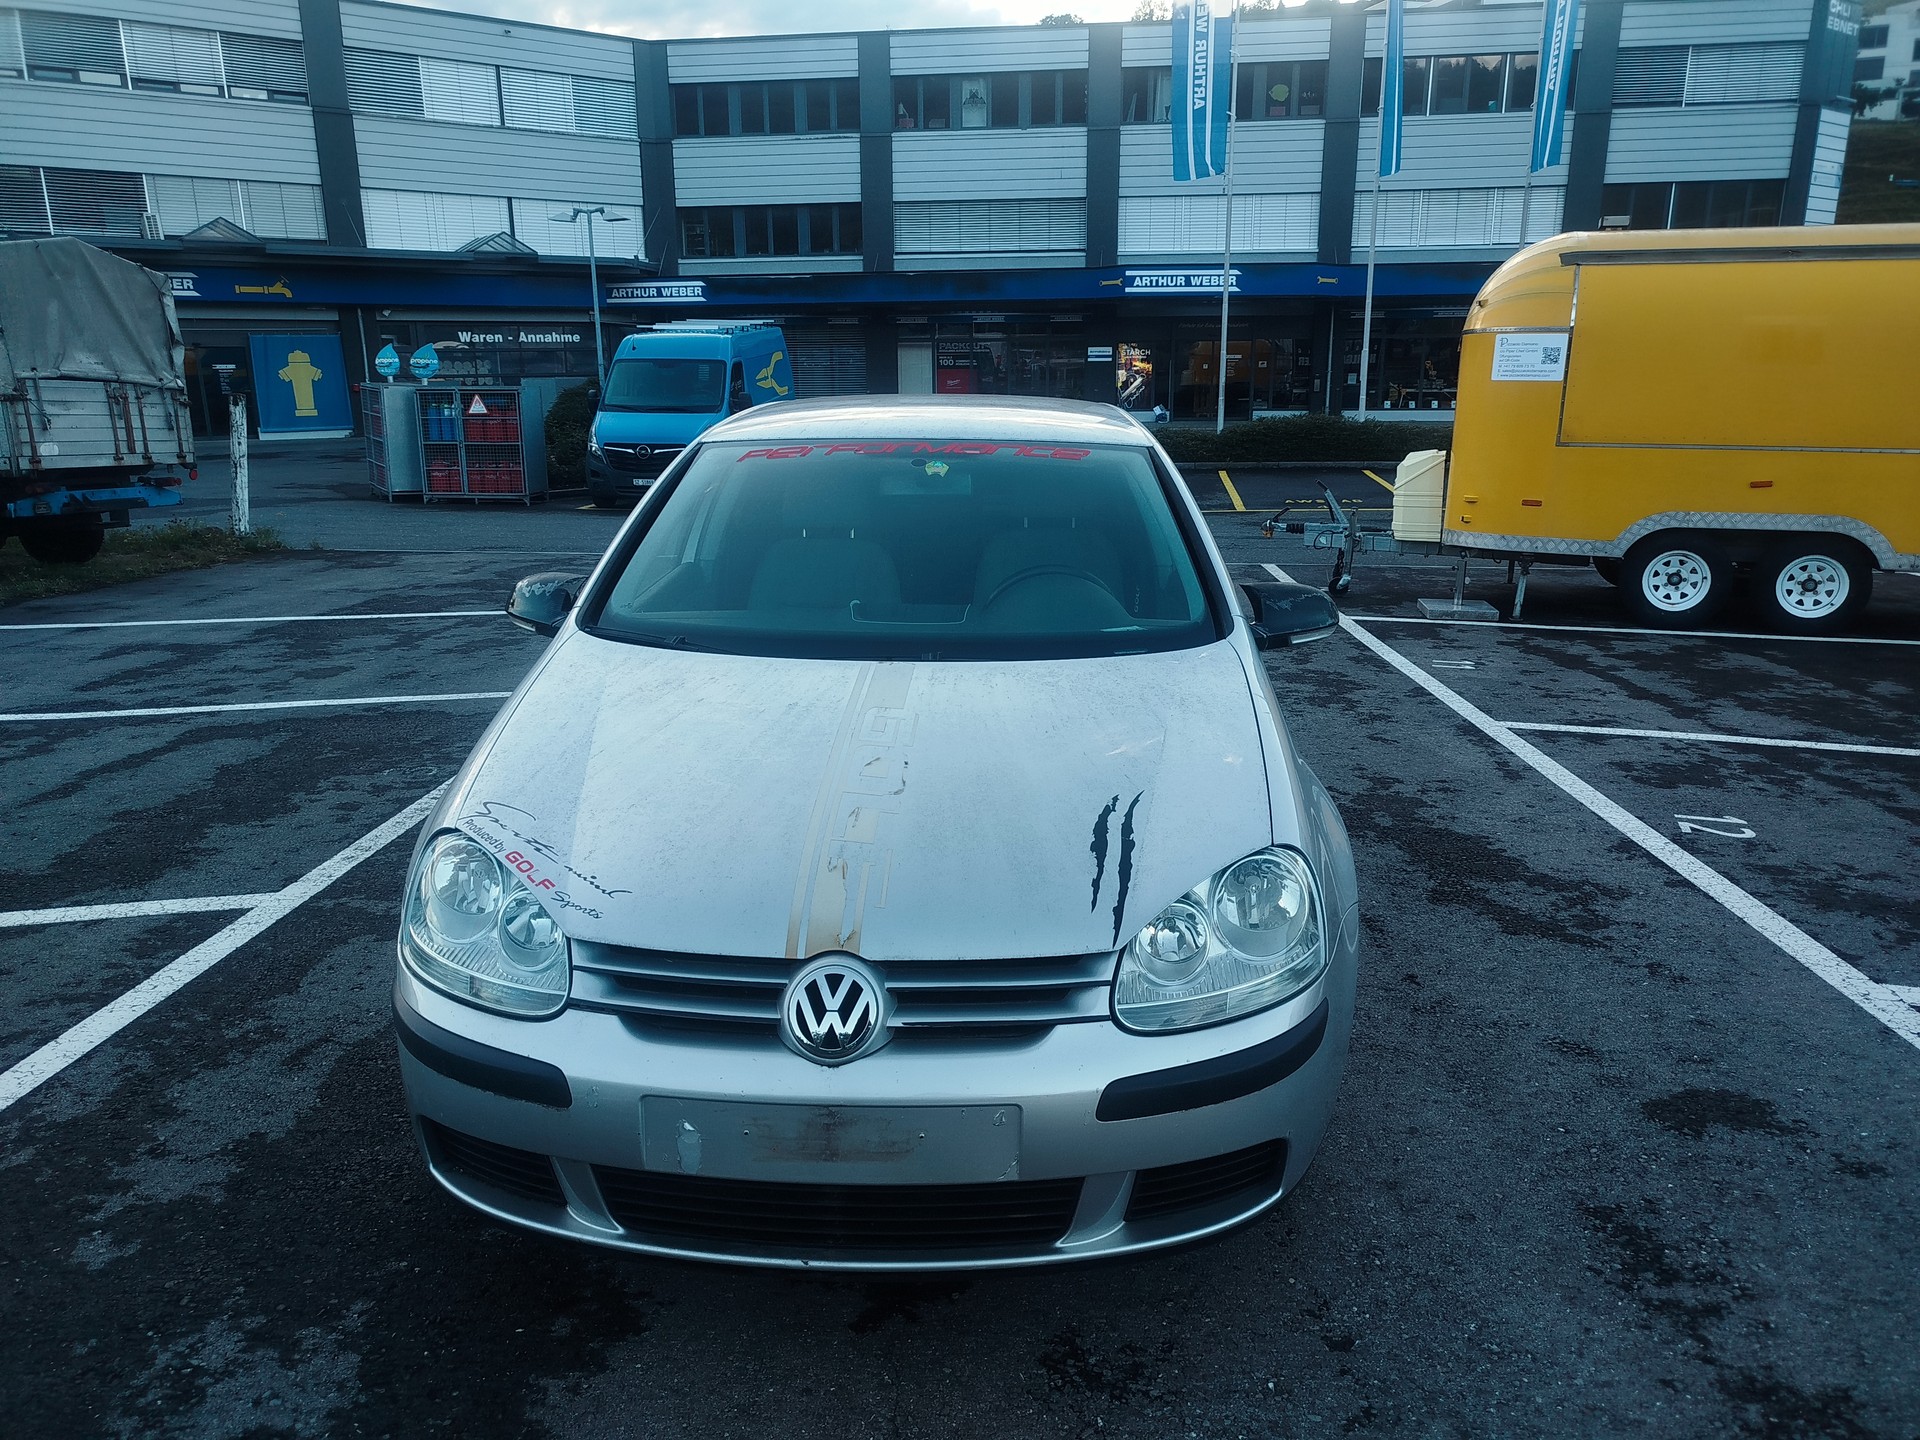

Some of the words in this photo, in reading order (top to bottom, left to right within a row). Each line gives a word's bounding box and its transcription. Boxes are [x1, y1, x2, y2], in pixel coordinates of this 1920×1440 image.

[1827, 17, 1858, 36] EBNET
[1548, 15, 1564, 91] ARTHUR
[1133, 275, 1186, 287] ARTHUR
[1190, 275, 1237, 287] WEBER
[612, 287, 658, 298] ARTHUR
[662, 286, 702, 297] WEBER
[458, 331, 504, 343] Waren
[519, 331, 581, 343] Annahme
[1674, 813, 1757, 839] 12
[504, 850, 556, 890] GOLF
[551, 890, 605, 919] Sports
